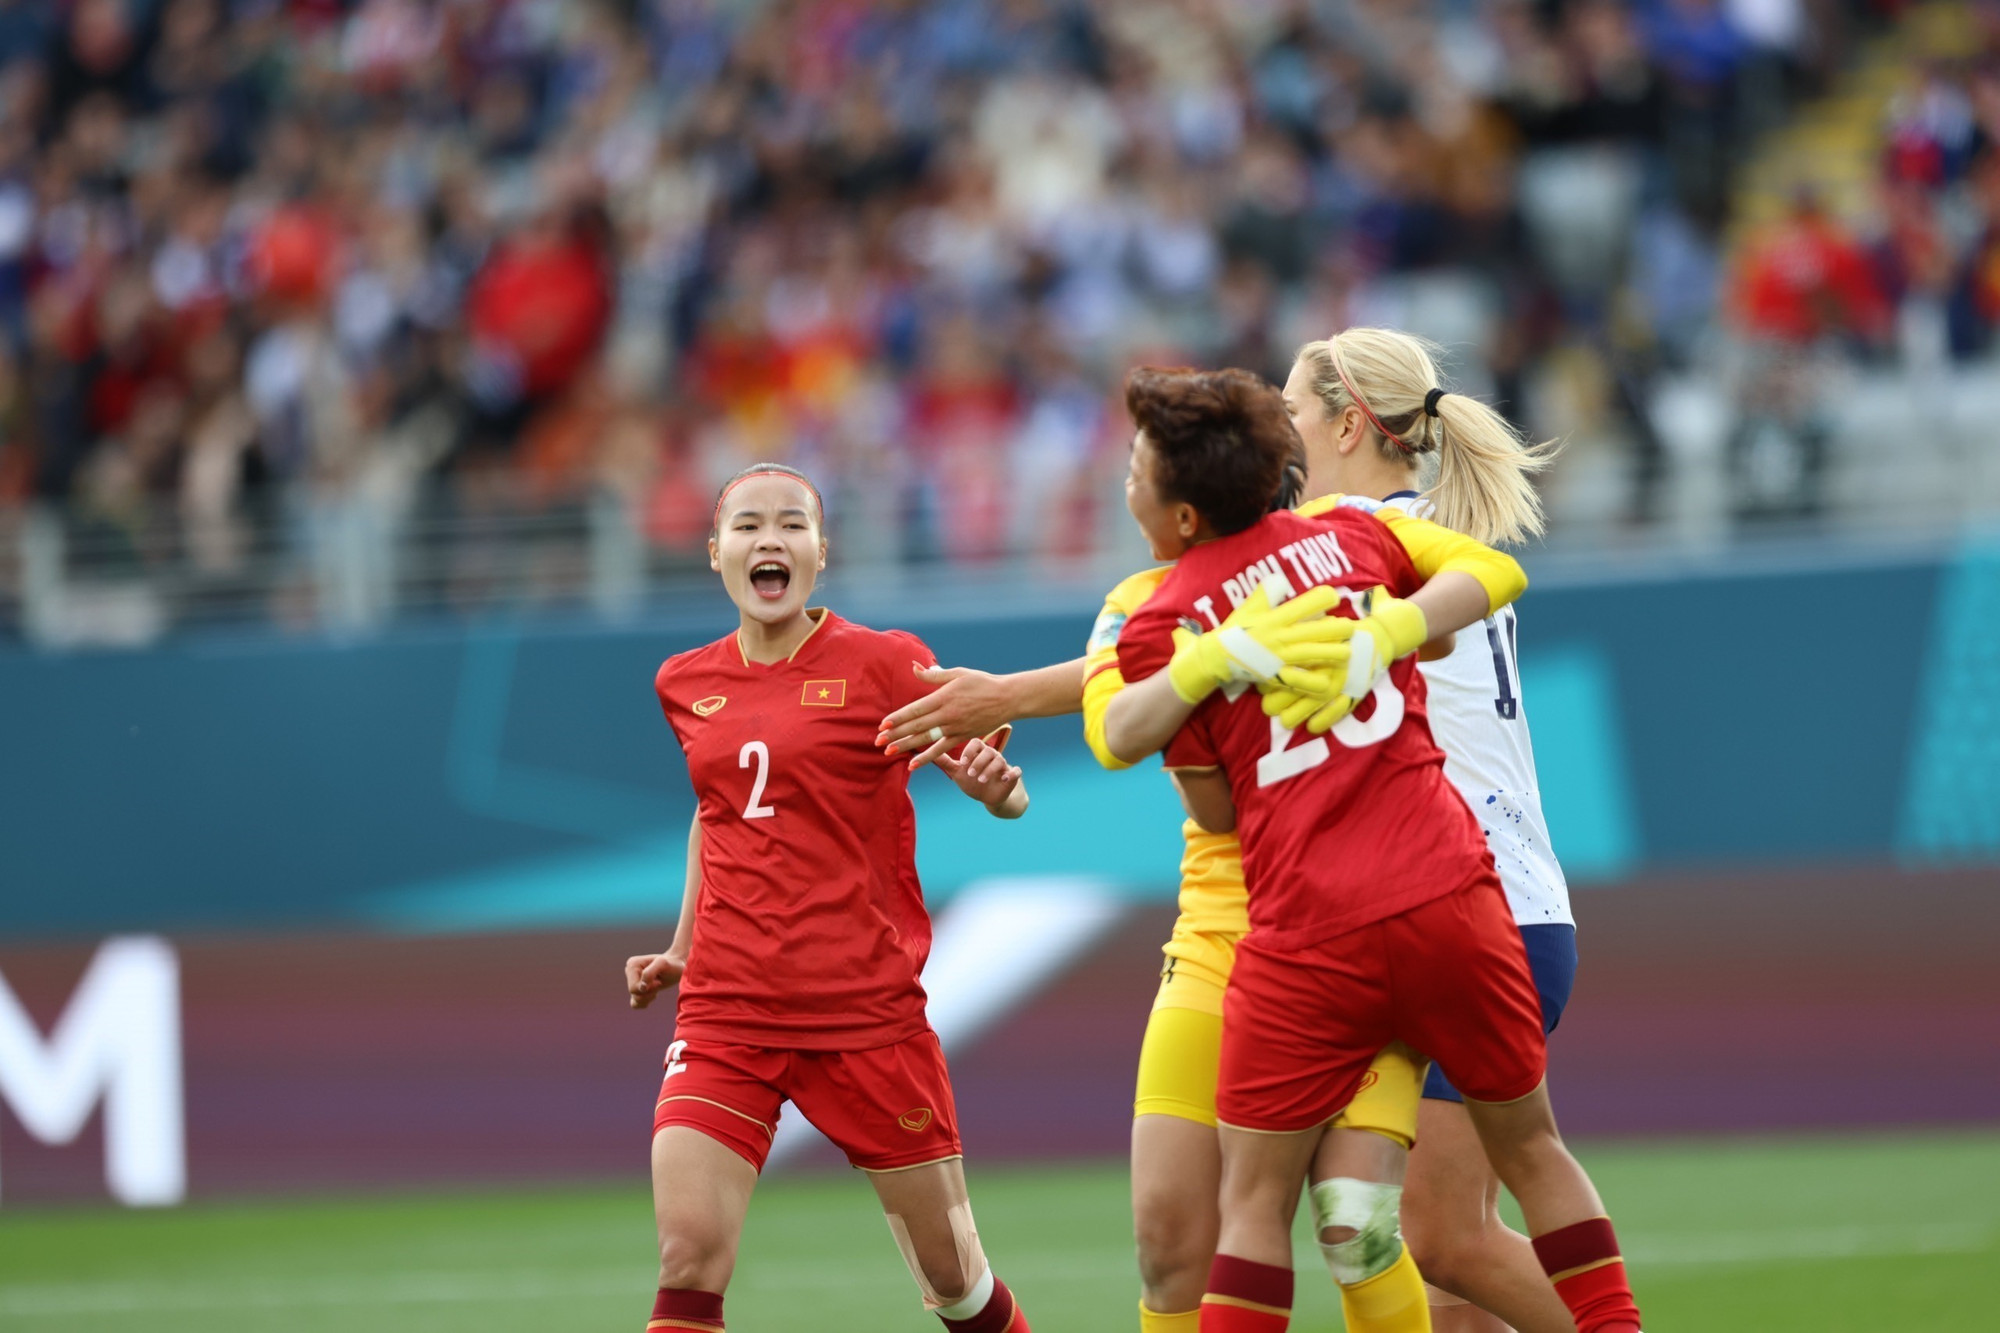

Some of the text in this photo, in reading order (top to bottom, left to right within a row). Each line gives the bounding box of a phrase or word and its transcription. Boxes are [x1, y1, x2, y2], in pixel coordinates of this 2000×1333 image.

[1278, 530, 1354, 590] THUY
[738, 740, 775, 819] 2
[663, 1039, 688, 1082] 2
